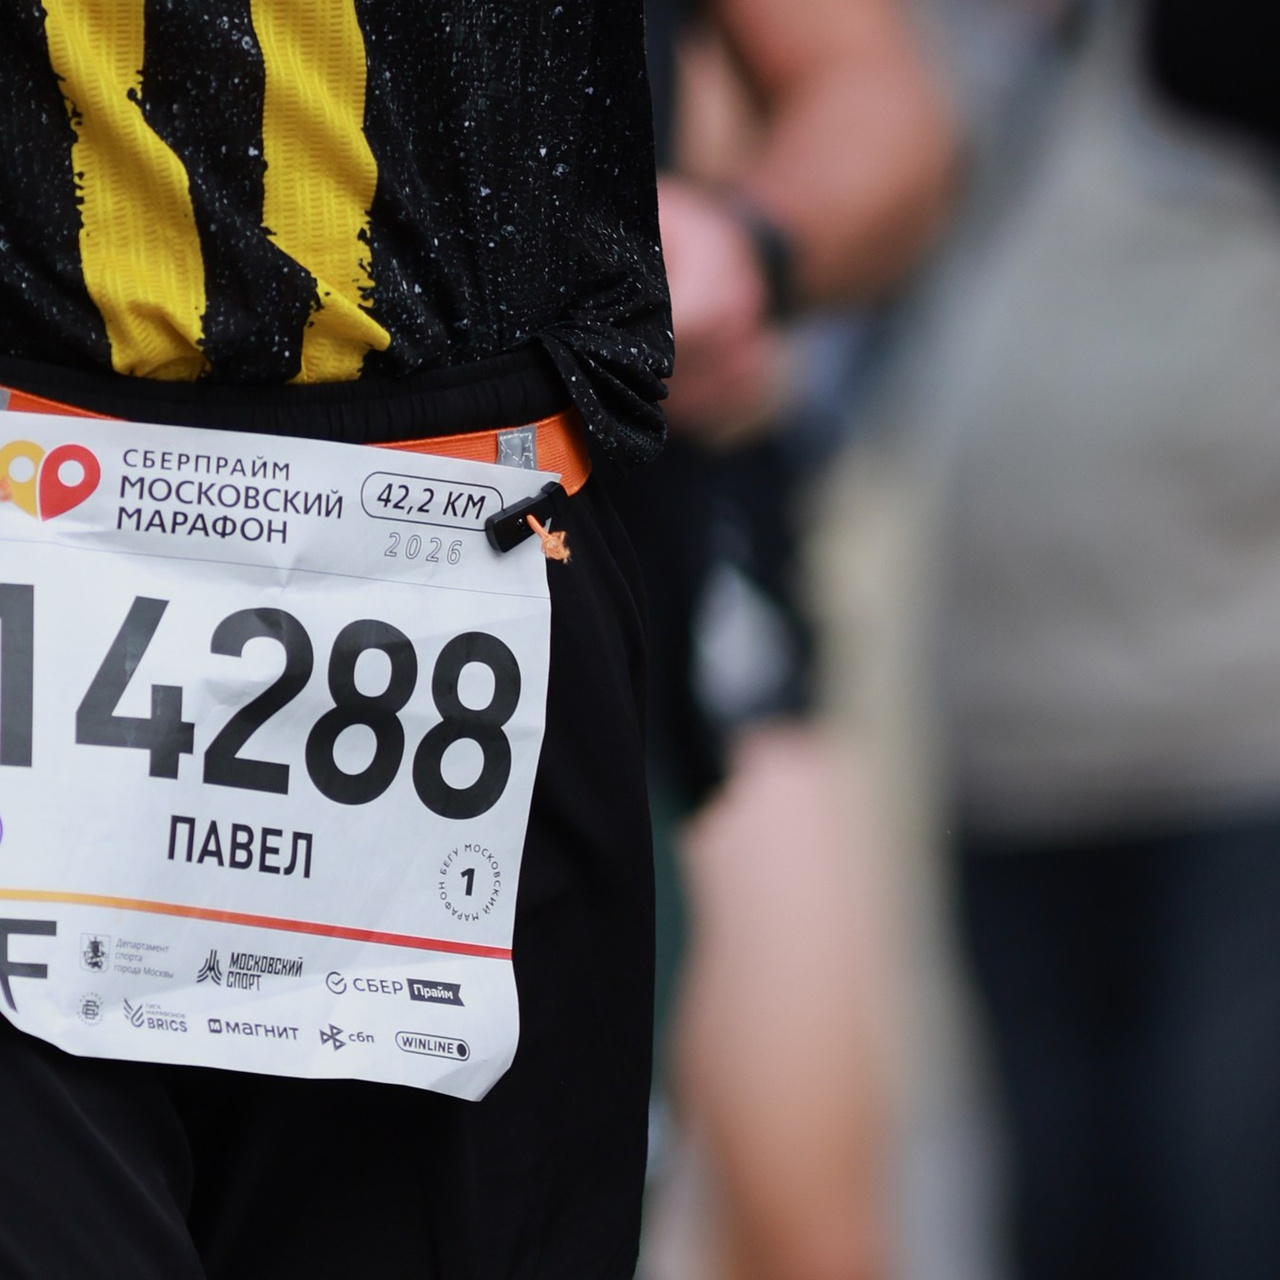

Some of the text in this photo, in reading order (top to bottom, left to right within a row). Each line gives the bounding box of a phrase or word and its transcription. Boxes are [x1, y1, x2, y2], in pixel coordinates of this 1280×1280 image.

[122, 448, 291, 481] СБЕРПРАЙМ
[119, 476, 344, 520] МОСКОВСКИЙ
[376, 481, 487, 519] 42,2 КМ
[116, 506, 289, 544] МАРАФОН
[384, 532, 464, 565] 2026
[166, 814, 314, 879] ПАВЕЛ
[438, 843, 501, 922] БЕГУ МОСКОВСКИЙ МАРАФОН
[460, 867, 475, 897] 1
[115, 938, 169, 953] Департамент
[115, 951, 143, 963] спорта
[113, 964, 175, 979] города Москвы
[228, 951, 303, 978] МОСКОВСКИЙ
[226, 970, 261, 991] СПОРТ
[352, 977, 454, 1000] СБЕР Прайм
[147, 1016, 187, 1033] BRICS
[348, 1032, 375, 1044] сбп
[401, 1035, 454, 1055] WINLINE
